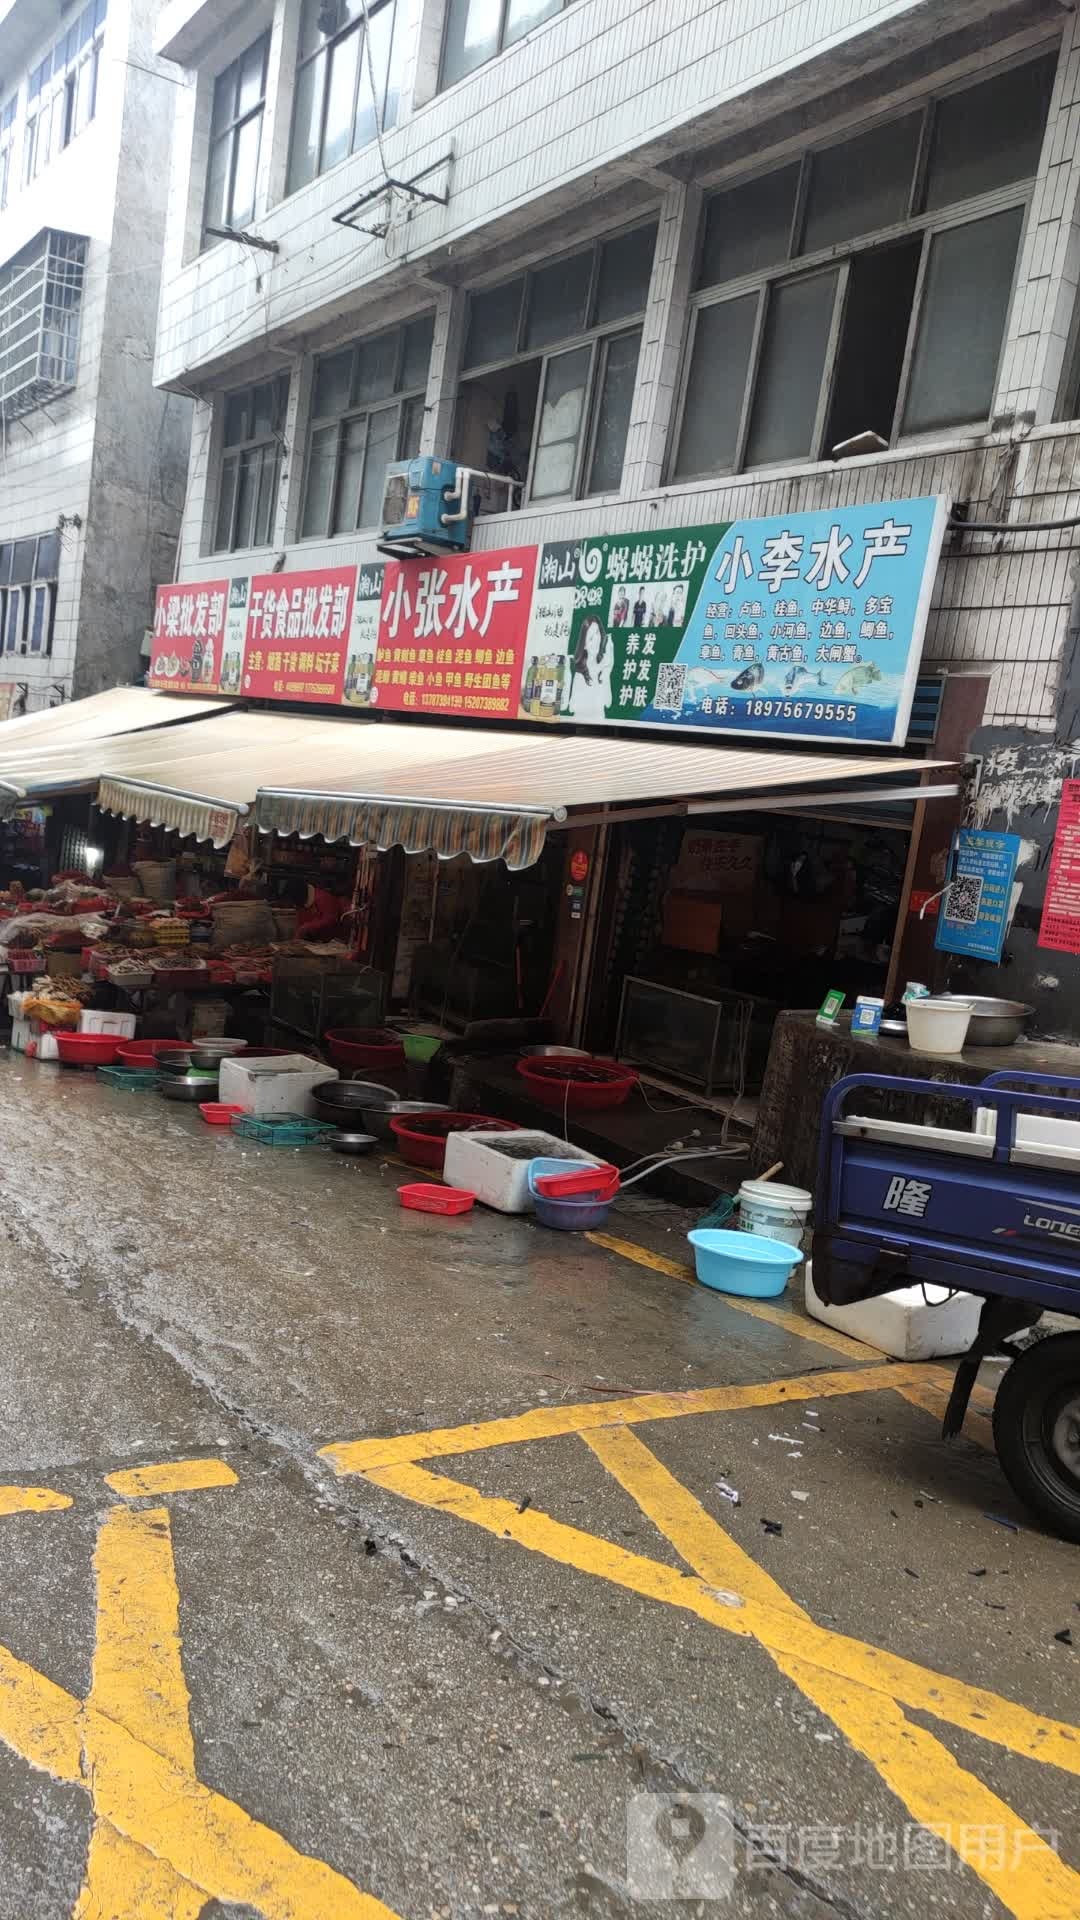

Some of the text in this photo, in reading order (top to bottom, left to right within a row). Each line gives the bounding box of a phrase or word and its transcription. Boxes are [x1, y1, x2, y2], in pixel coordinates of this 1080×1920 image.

[541, 551, 575, 585] 湘山
[605, 540, 707, 582] 蜗蜗洗护
[714, 518, 912, 594] 小李水产
[153, 592, 225, 637] 小梁批发部
[249, 583, 350, 639] 干货食品批发部
[382, 560, 523, 639] 小张水产
[626, 633, 657, 655] 养发
[623, 660, 651, 681] 护发
[619, 685, 648, 707] 护肤
[882, 1175, 932, 1218] 隆
